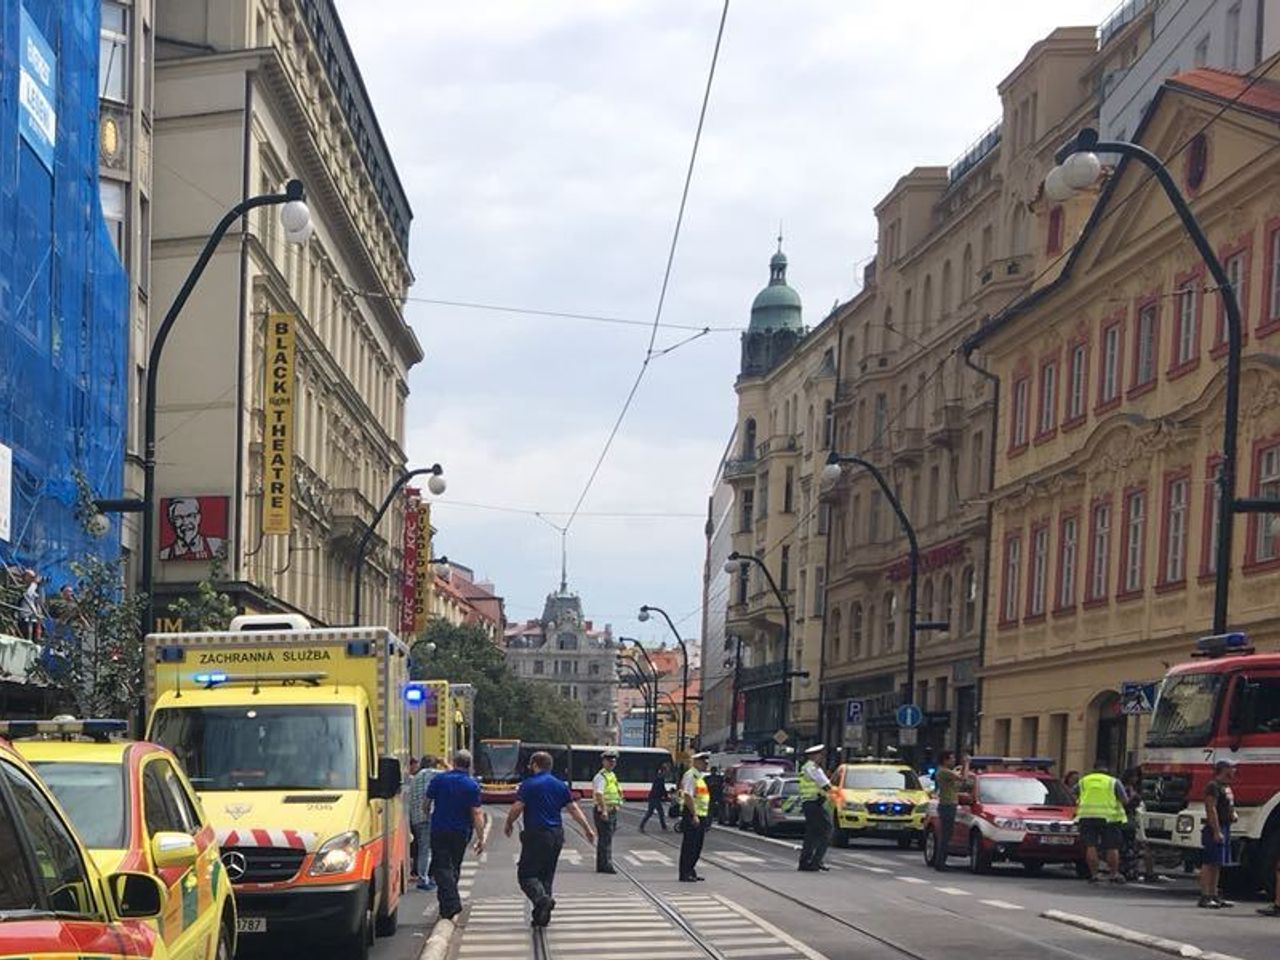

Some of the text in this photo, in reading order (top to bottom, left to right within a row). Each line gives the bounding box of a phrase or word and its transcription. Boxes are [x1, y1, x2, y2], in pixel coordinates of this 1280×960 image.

[273, 323, 288, 394] BLACK
[271, 411, 287, 508] THEATRE
[283, 649, 332, 661] SLUŽBA
